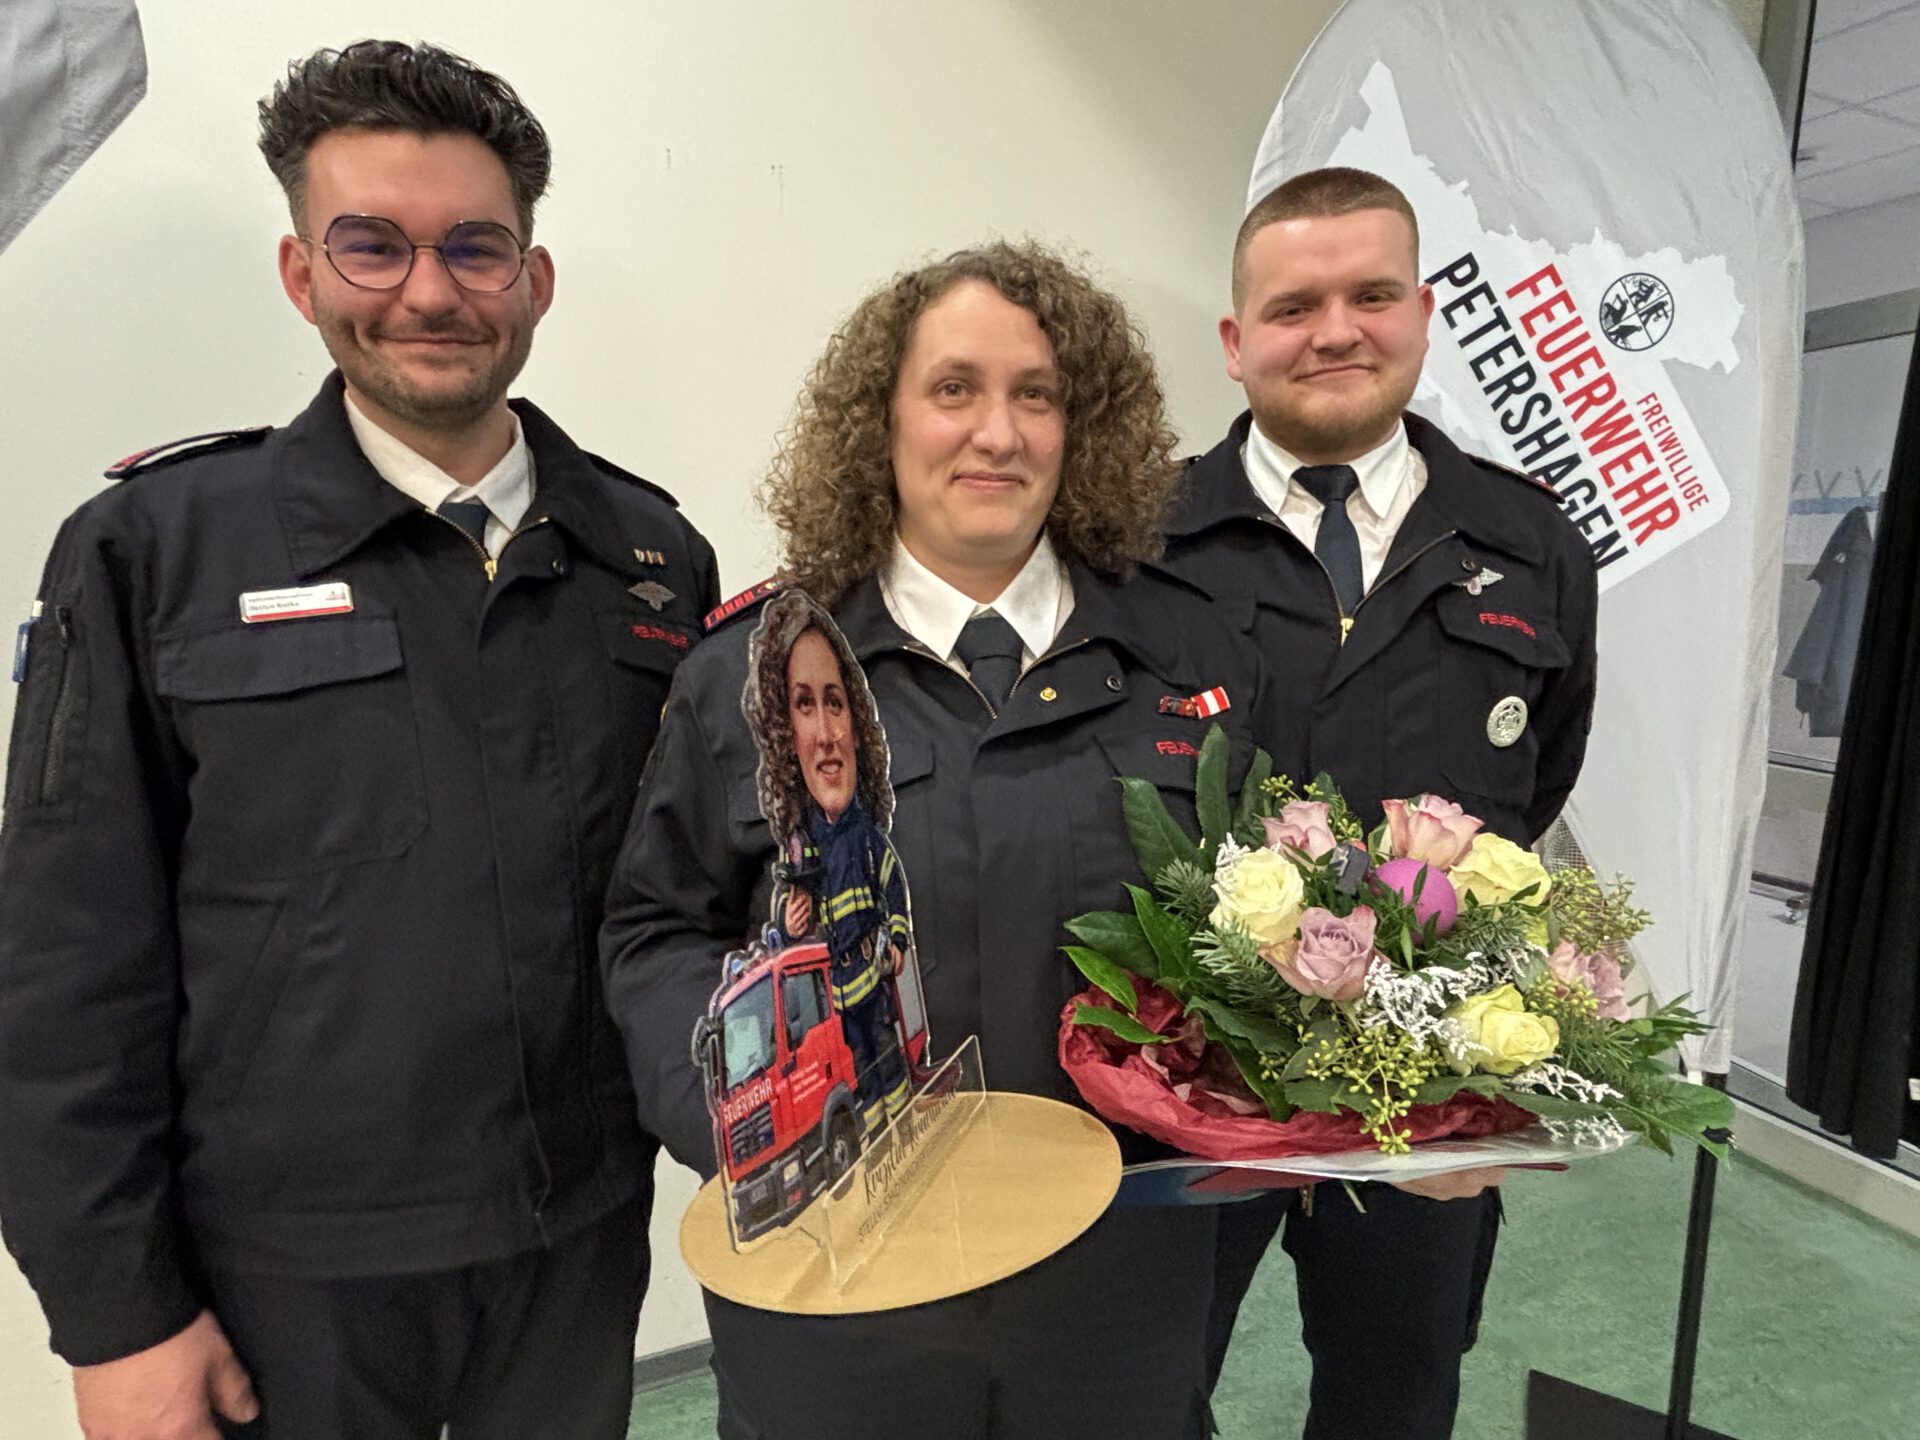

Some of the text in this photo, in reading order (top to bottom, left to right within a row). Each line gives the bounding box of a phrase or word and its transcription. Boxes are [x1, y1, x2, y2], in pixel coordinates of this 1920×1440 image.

[1424, 251, 1630, 571] PETERSHAGEN
[1505, 263, 1681, 547] FEUERWEHR
[1636, 392, 1710, 512] FREIWILLIGE
